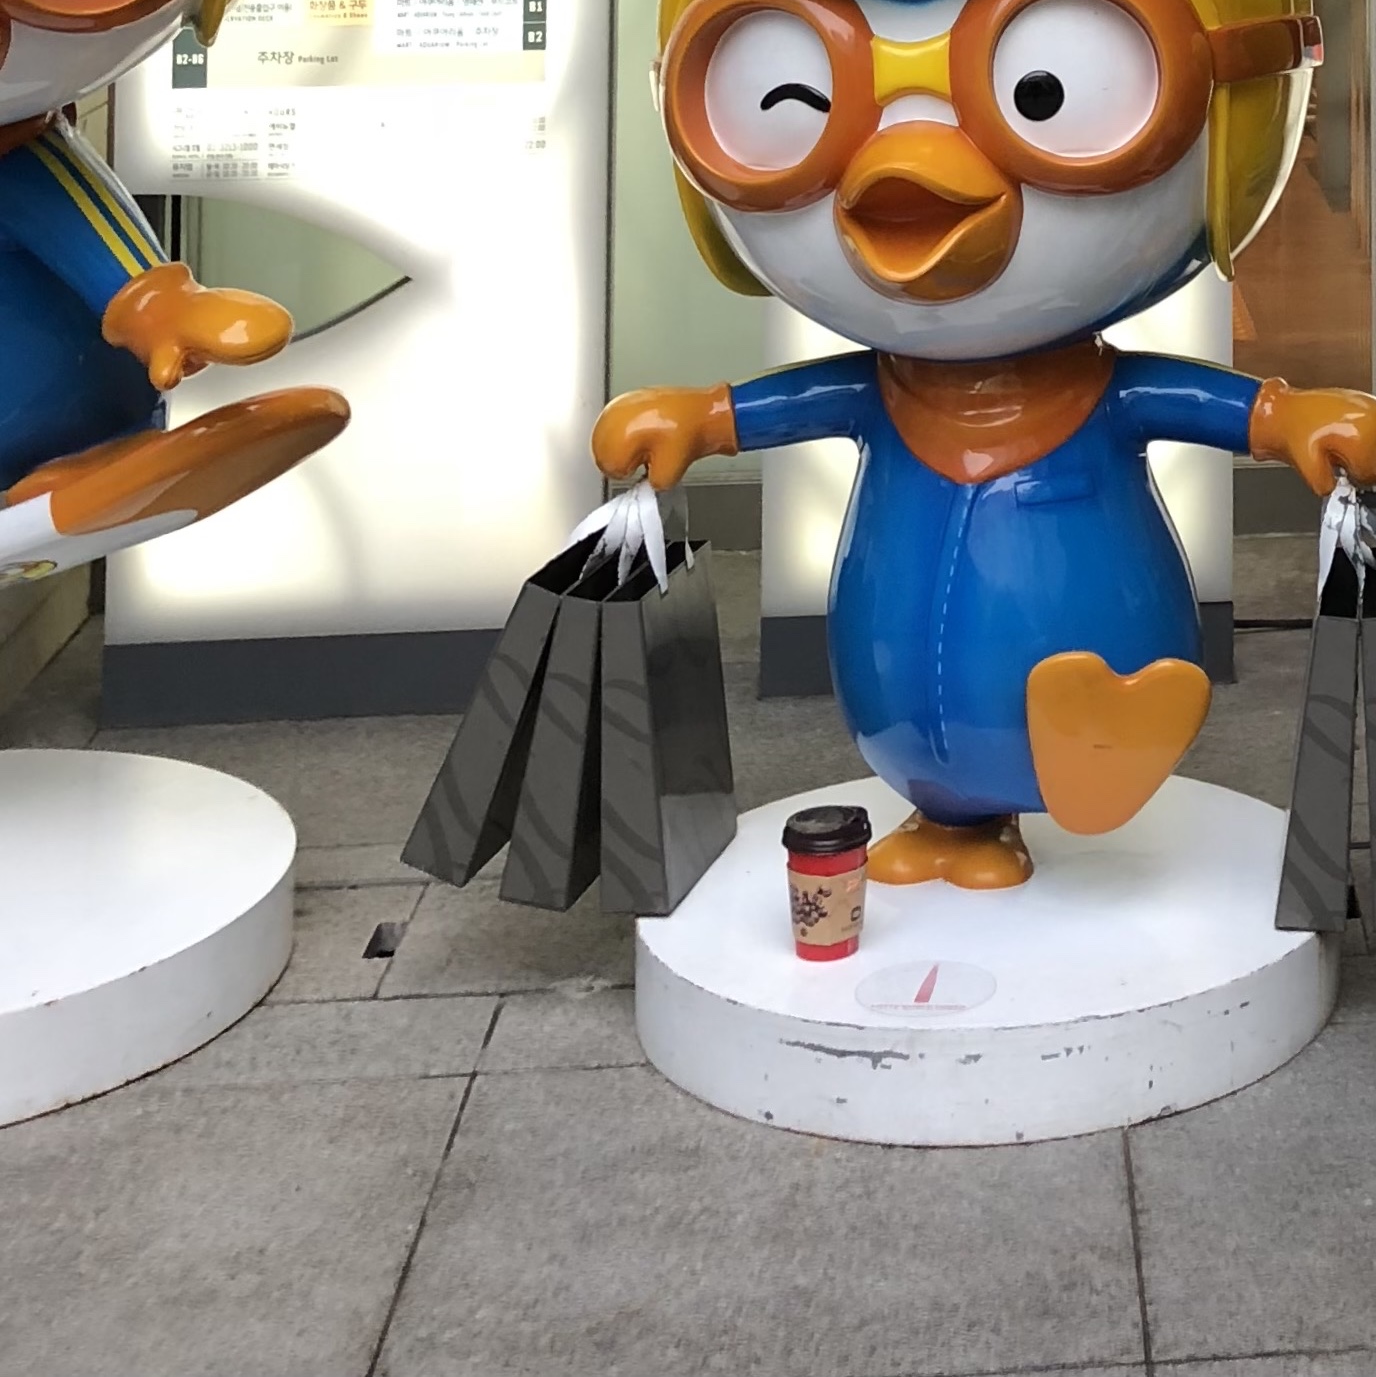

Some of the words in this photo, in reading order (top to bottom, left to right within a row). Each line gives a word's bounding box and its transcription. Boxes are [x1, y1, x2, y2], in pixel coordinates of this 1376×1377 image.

[529, 1, 542, 12] B1
[528, 31, 542, 42] B2
[258, 51, 294, 64] 주차장
[298, 55, 324, 64] Parking
